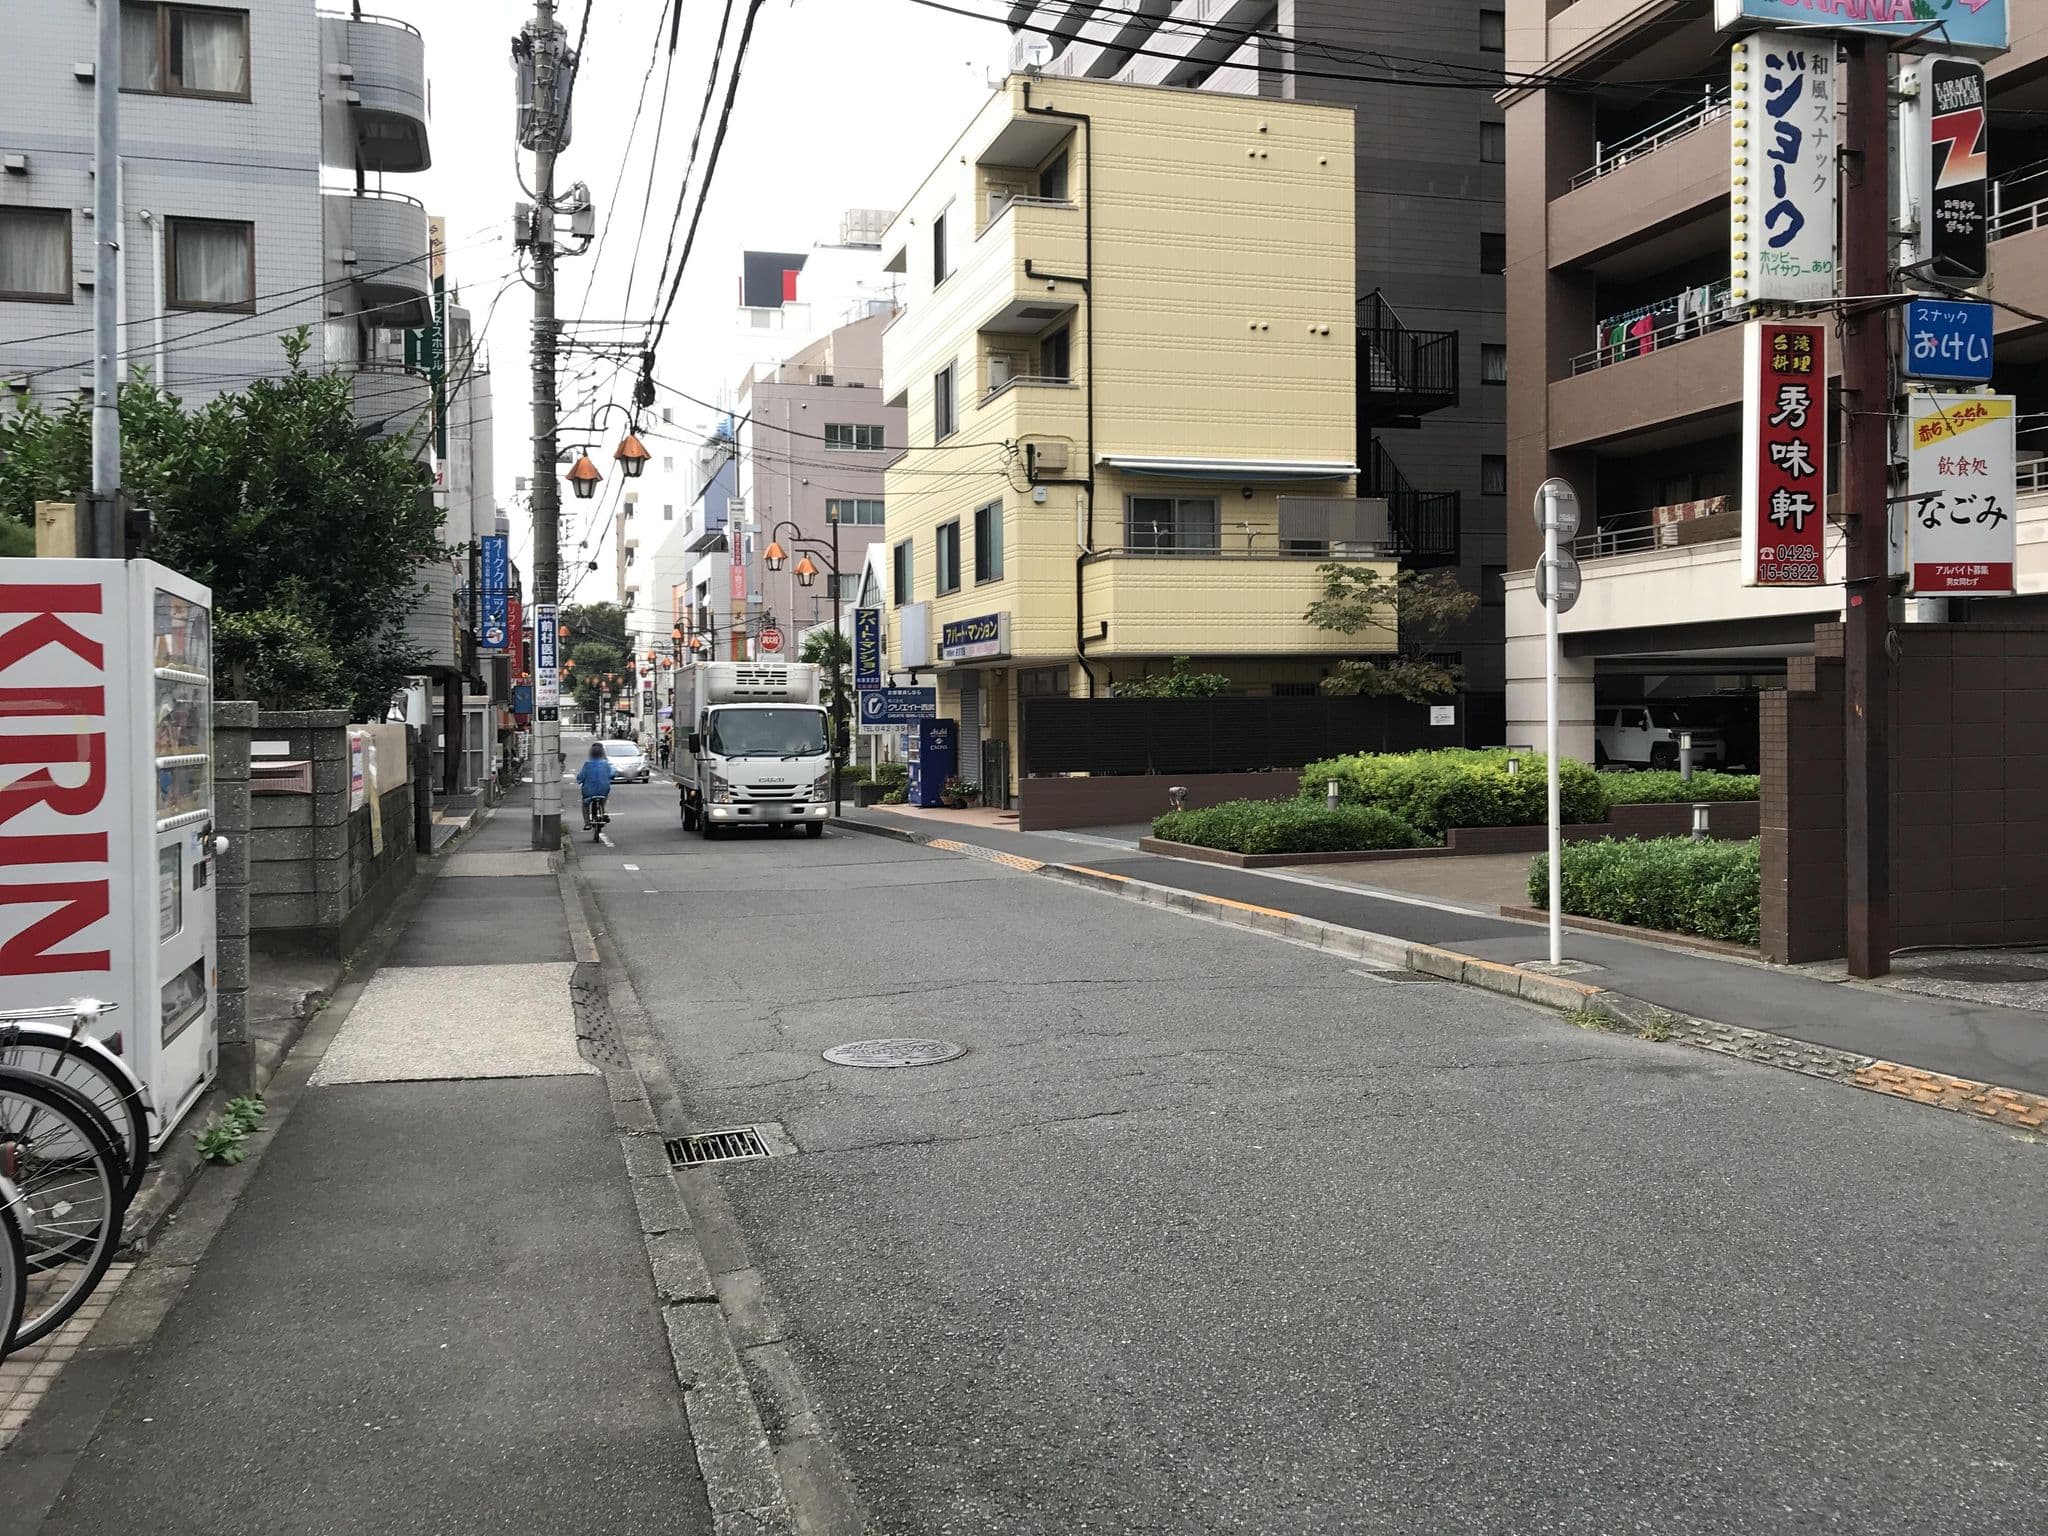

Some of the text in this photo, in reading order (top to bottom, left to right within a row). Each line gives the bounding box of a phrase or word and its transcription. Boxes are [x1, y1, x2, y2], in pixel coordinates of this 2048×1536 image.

[1934, 75, 1979, 98] KARAOKE
[1811, 54, 1830, 194] 和風スナック
[1764, 50, 1806, 248] ジョーク
[1930, 106, 1987, 191] Z
[1760, 250, 1800, 264] ホッピー
[1917, 308, 1969, 324] スナック
[1772, 354, 1811, 372] 料理
[1914, 330, 1989, 362] おけい
[1770, 386, 1815, 530] 秀味軒
[1938, 456, 1988, 476] 飲食処
[1917, 494, 2008, 530] なごみ
[1760, 563, 1818, 580] 15-5322
[541, 621, 554, 667] 前村医院
[0, 583, 111, 977] KIRIN
